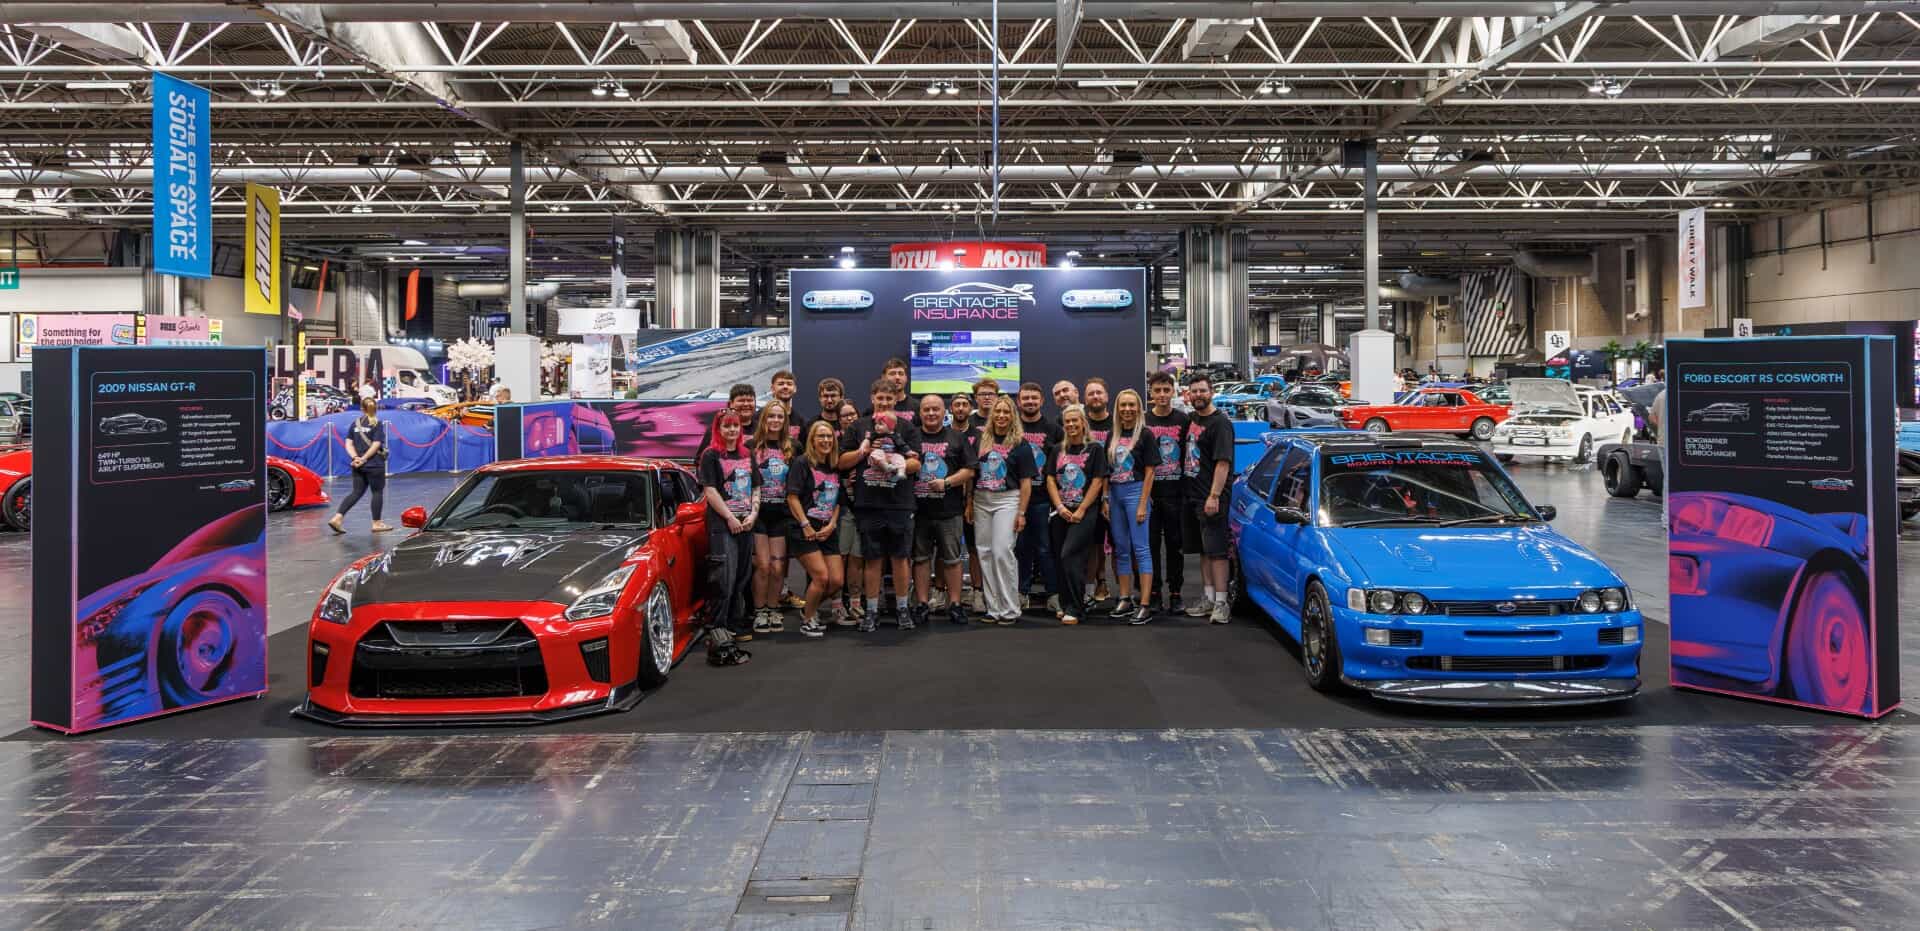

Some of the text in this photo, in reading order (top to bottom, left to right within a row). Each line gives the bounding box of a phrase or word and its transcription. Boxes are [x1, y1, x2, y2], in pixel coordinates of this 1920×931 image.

[169, 91, 188, 260] SOCIAL SPACE
[186, 98, 197, 260] THE GRAVITY
[255, 192, 271, 304] HOLY
[982, 249, 1045, 268] MOTUL
[913, 296, 1018, 308] BRENTACRE
[913, 308, 1018, 319] INSURANCE
[42, 328, 101, 338] Something for
[1684, 373, 1843, 383] FORD ESCORT RS COSWORTH
[98, 382, 196, 393] 2009 NISSAN GT-R
[1330, 452, 1481, 465] BRENTACRE
[1346, 459, 1393, 467] MODIFIED
